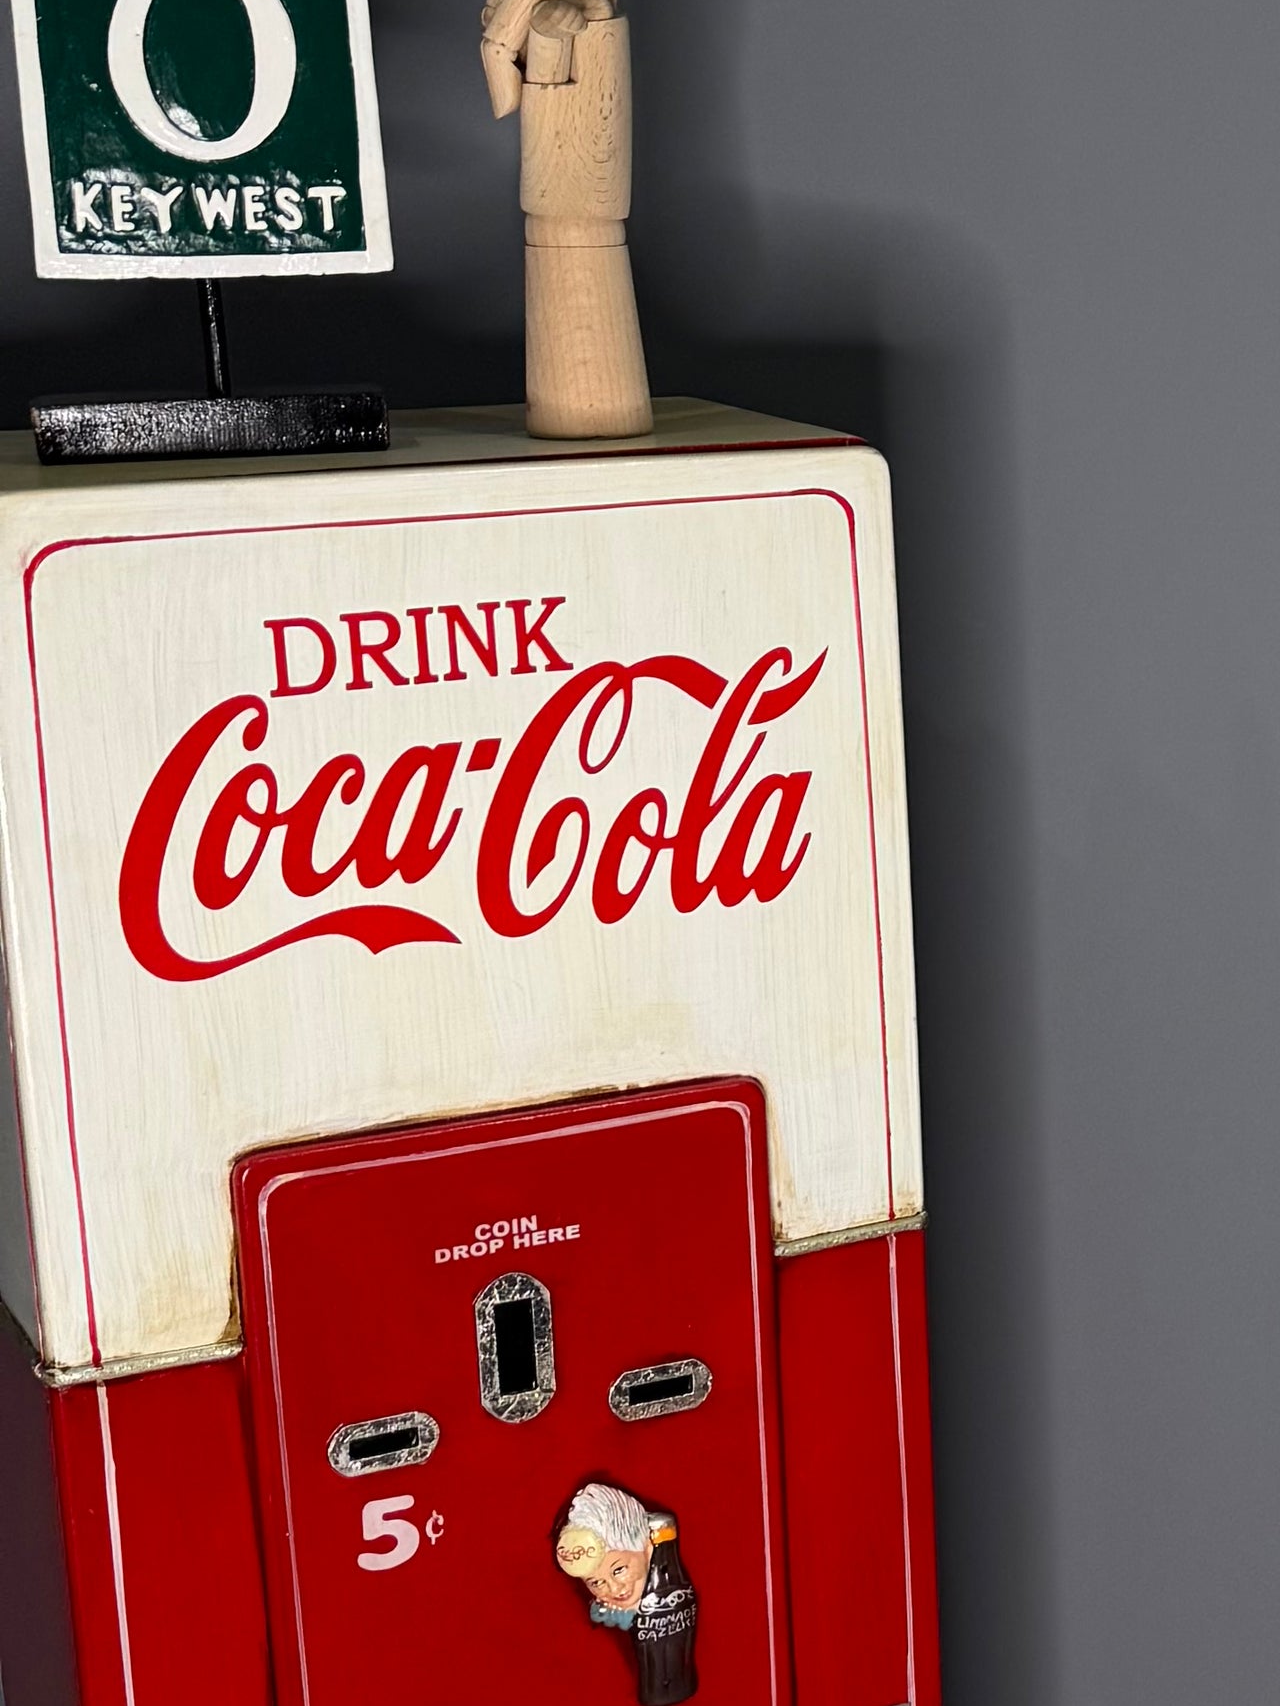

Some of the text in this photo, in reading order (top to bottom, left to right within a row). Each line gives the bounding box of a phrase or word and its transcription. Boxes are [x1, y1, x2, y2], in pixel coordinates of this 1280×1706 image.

[71, 181, 347, 233] KEY WEST
[264, 597, 574, 698] DRINK
[118, 645, 828, 983] Coca-Cola
[434, 1224, 581, 1264] DROP HERE
[475, 1215, 538, 1241] COIN
[357, 1494, 444, 1571] 5¢
